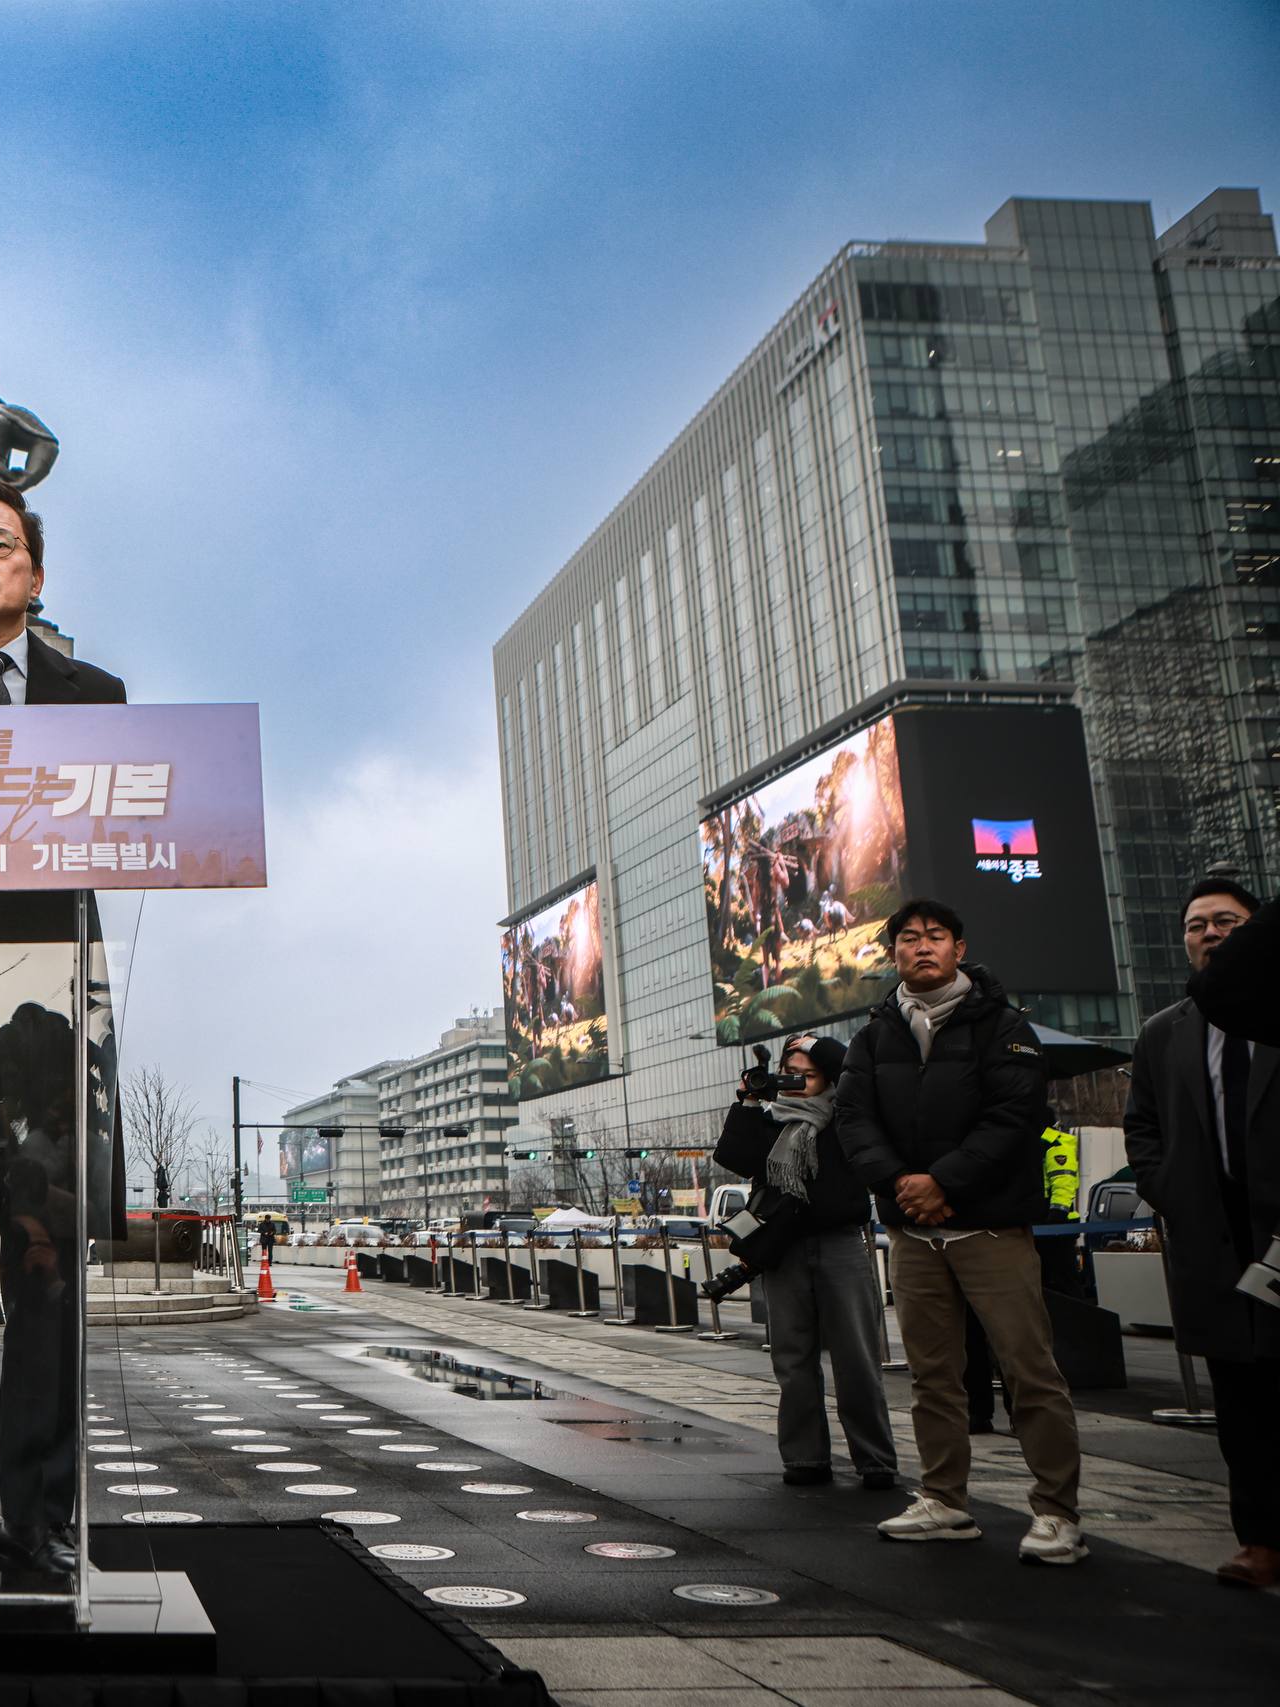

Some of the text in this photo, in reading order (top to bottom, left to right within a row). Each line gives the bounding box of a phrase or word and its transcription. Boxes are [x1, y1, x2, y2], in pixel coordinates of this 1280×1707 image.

[52, 763, 170, 816] 기본
[32, 842, 176, 872] 기본특별시
[1007, 859, 1043, 883] 종로
